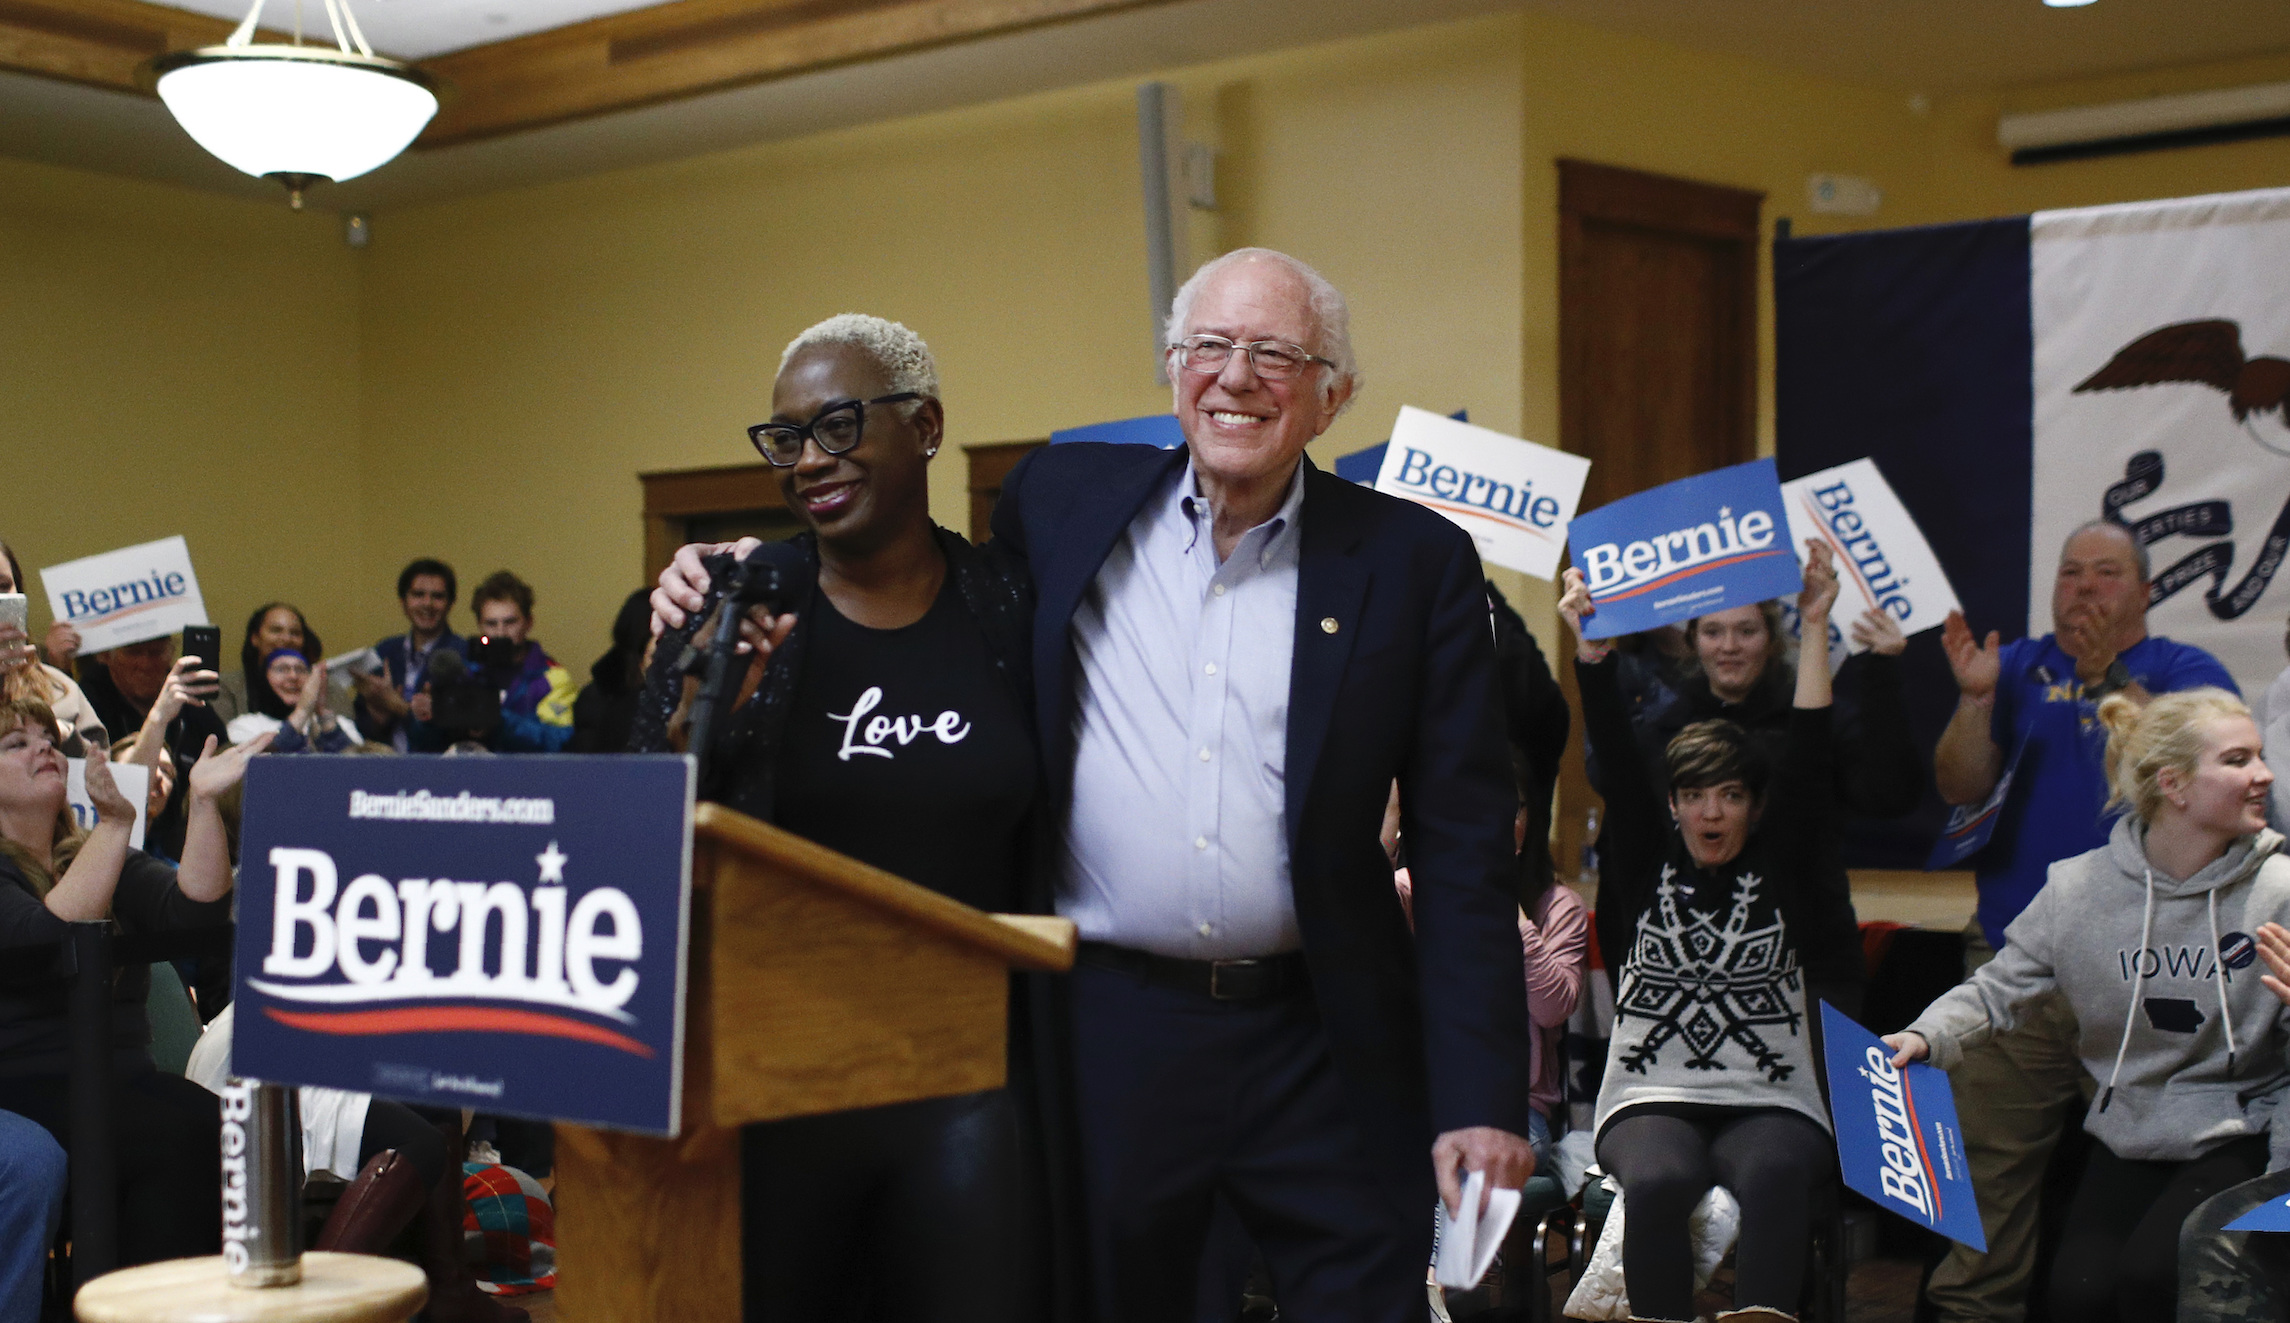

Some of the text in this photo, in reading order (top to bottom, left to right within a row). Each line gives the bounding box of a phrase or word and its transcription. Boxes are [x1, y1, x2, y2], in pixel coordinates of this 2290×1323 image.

[1395, 446, 1560, 529] Bernie
[2137, 506, 2213, 542] ERTIES
[1582, 506, 1776, 590] Bernie
[1812, 481, 1915, 622] Bernie
[60, 569, 186, 619] Bernie
[826, 686, 971, 761] Love
[349, 789, 555, 824] BernieSanders.com
[263, 840, 642, 1010] Bernie
[2118, 946, 2232, 983] IOWA
[1857, 1046, 1928, 1216] Bernie
[221, 1087, 260, 1275] Bernie
